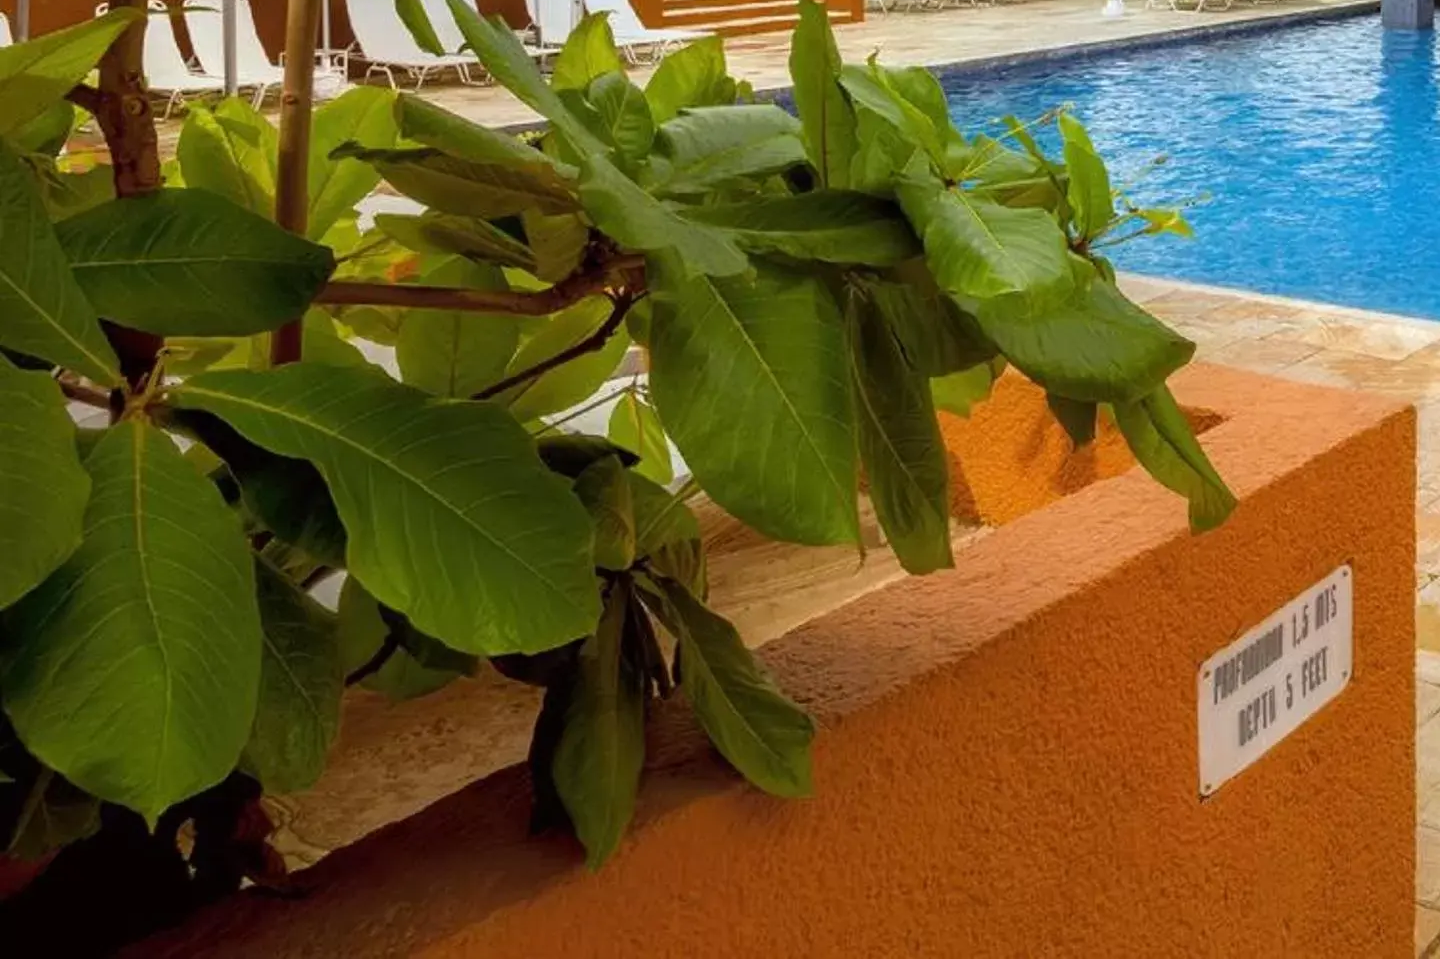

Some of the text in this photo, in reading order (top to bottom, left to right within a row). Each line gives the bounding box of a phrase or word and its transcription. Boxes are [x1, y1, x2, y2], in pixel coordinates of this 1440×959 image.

[1292, 604, 1309, 648] 1.5
[1286, 673, 1294, 710] 5
[1302, 646, 1328, 698] FEET
